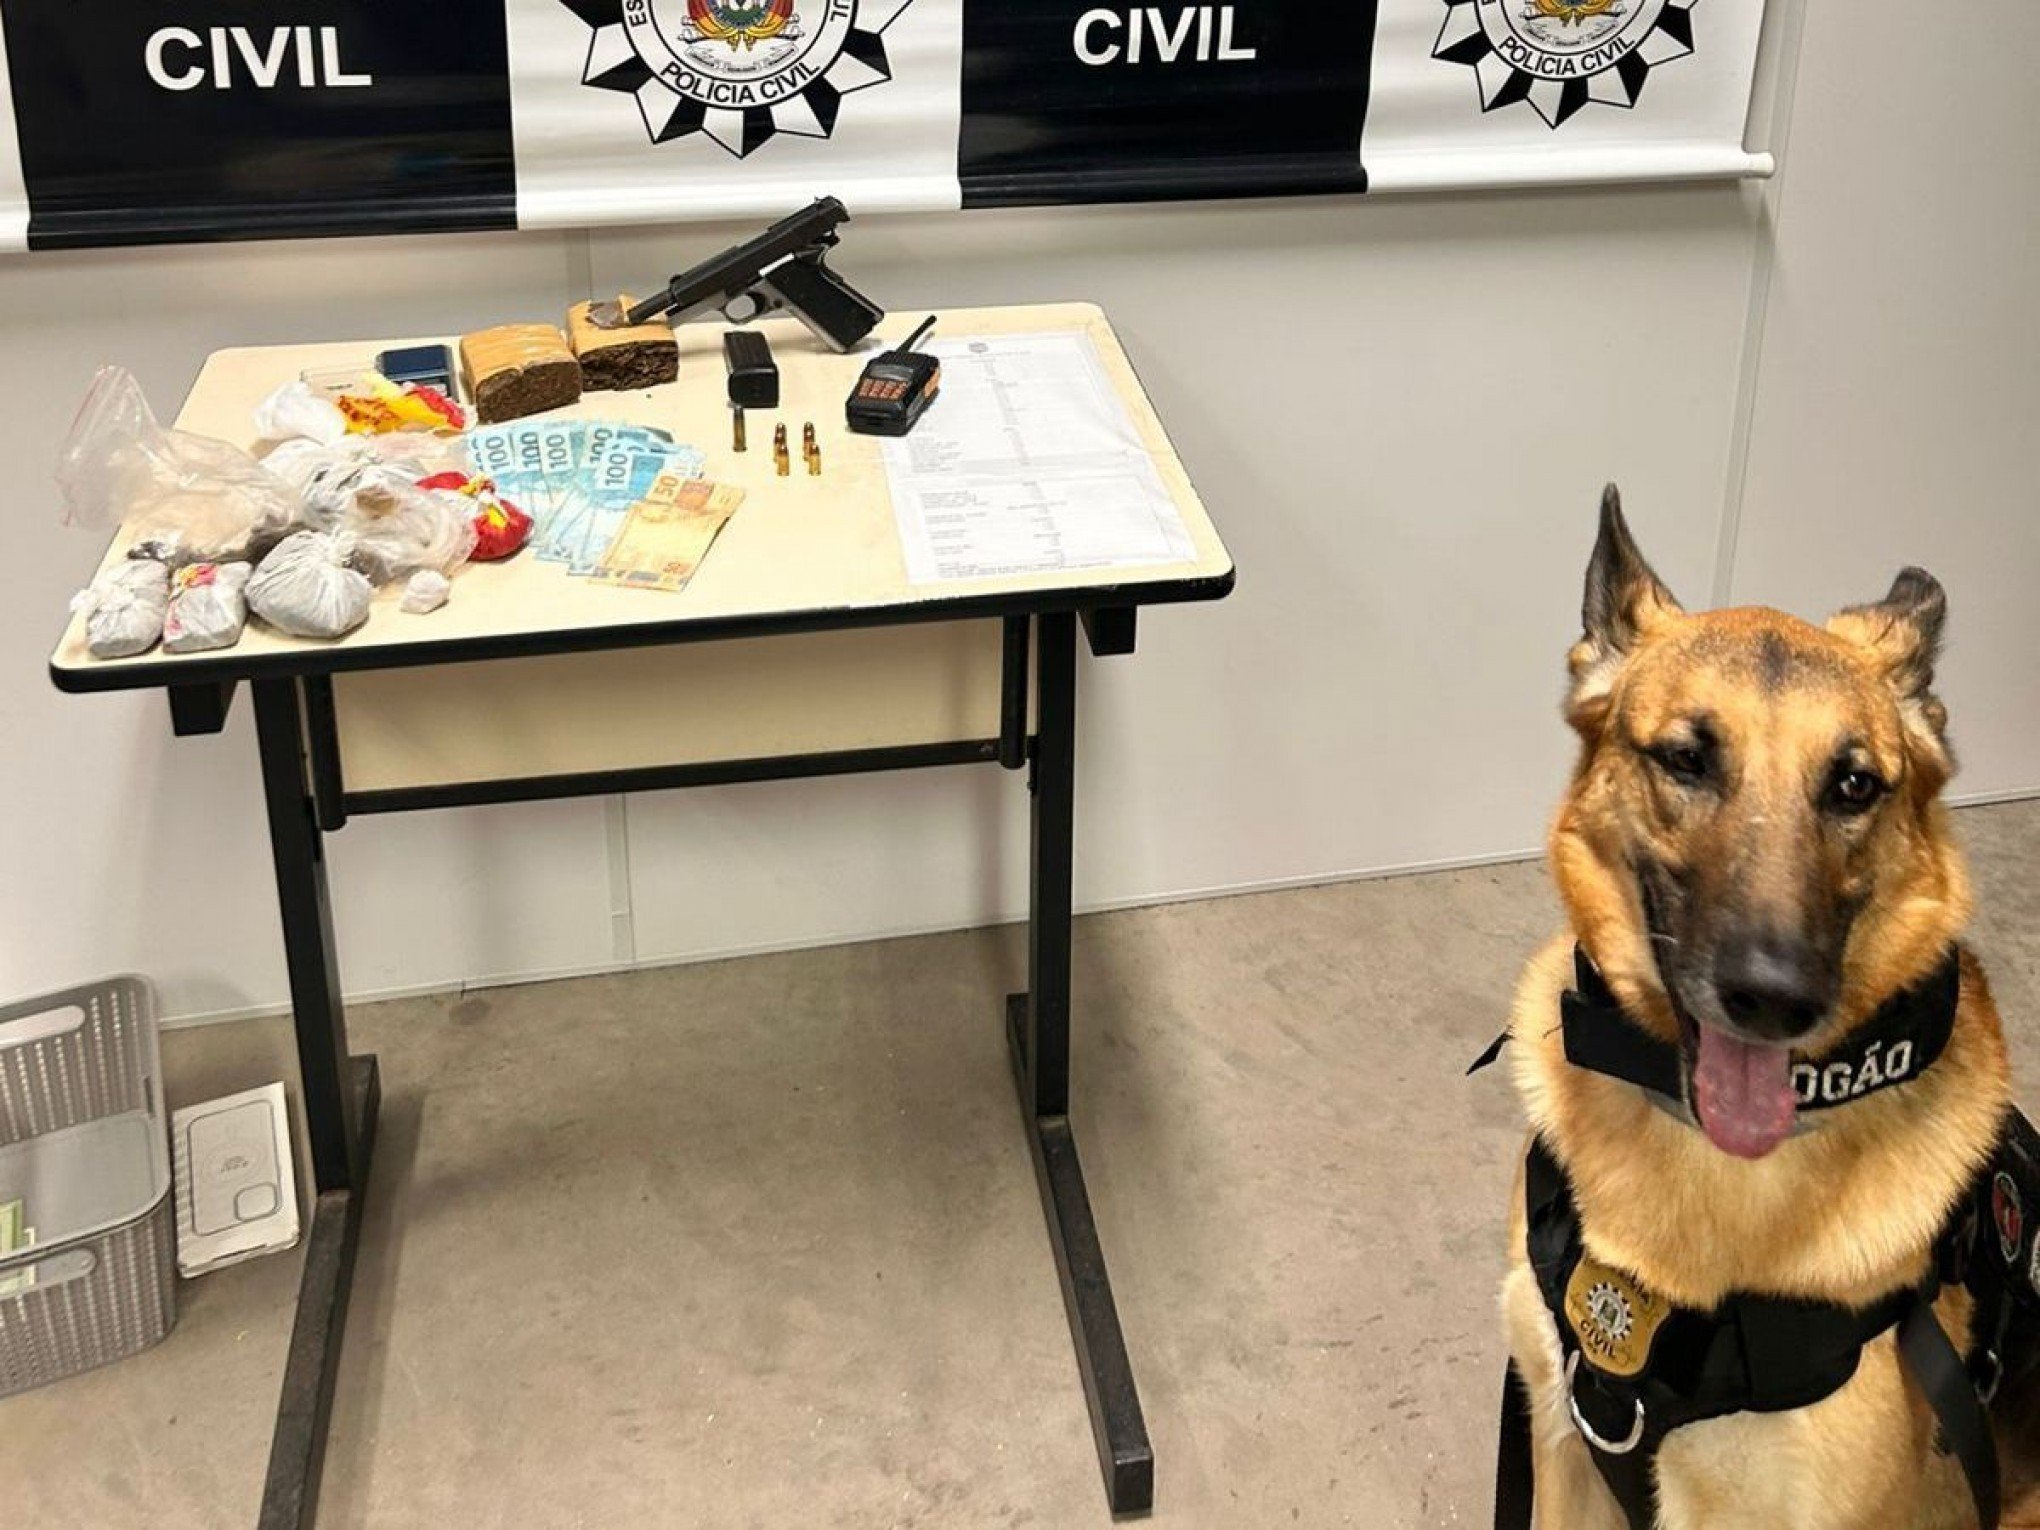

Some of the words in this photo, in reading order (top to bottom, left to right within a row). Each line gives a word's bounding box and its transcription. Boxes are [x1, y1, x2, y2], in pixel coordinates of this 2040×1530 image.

[1073, 6, 1256, 66] CIVIL
[1581, 36, 1636, 71] CIVIL
[145, 27, 373, 91] CIVIL
[760, 62, 820, 99] CIVIL
[485, 436, 510, 470] 100
[521, 432, 540, 467] 100
[546, 434, 568, 469] 100
[605, 453, 628, 486] 100
[652, 475, 678, 496] 50
[1790, 1040, 1913, 1103] OGÃO
[1580, 1319, 1617, 1359] CIVIL
